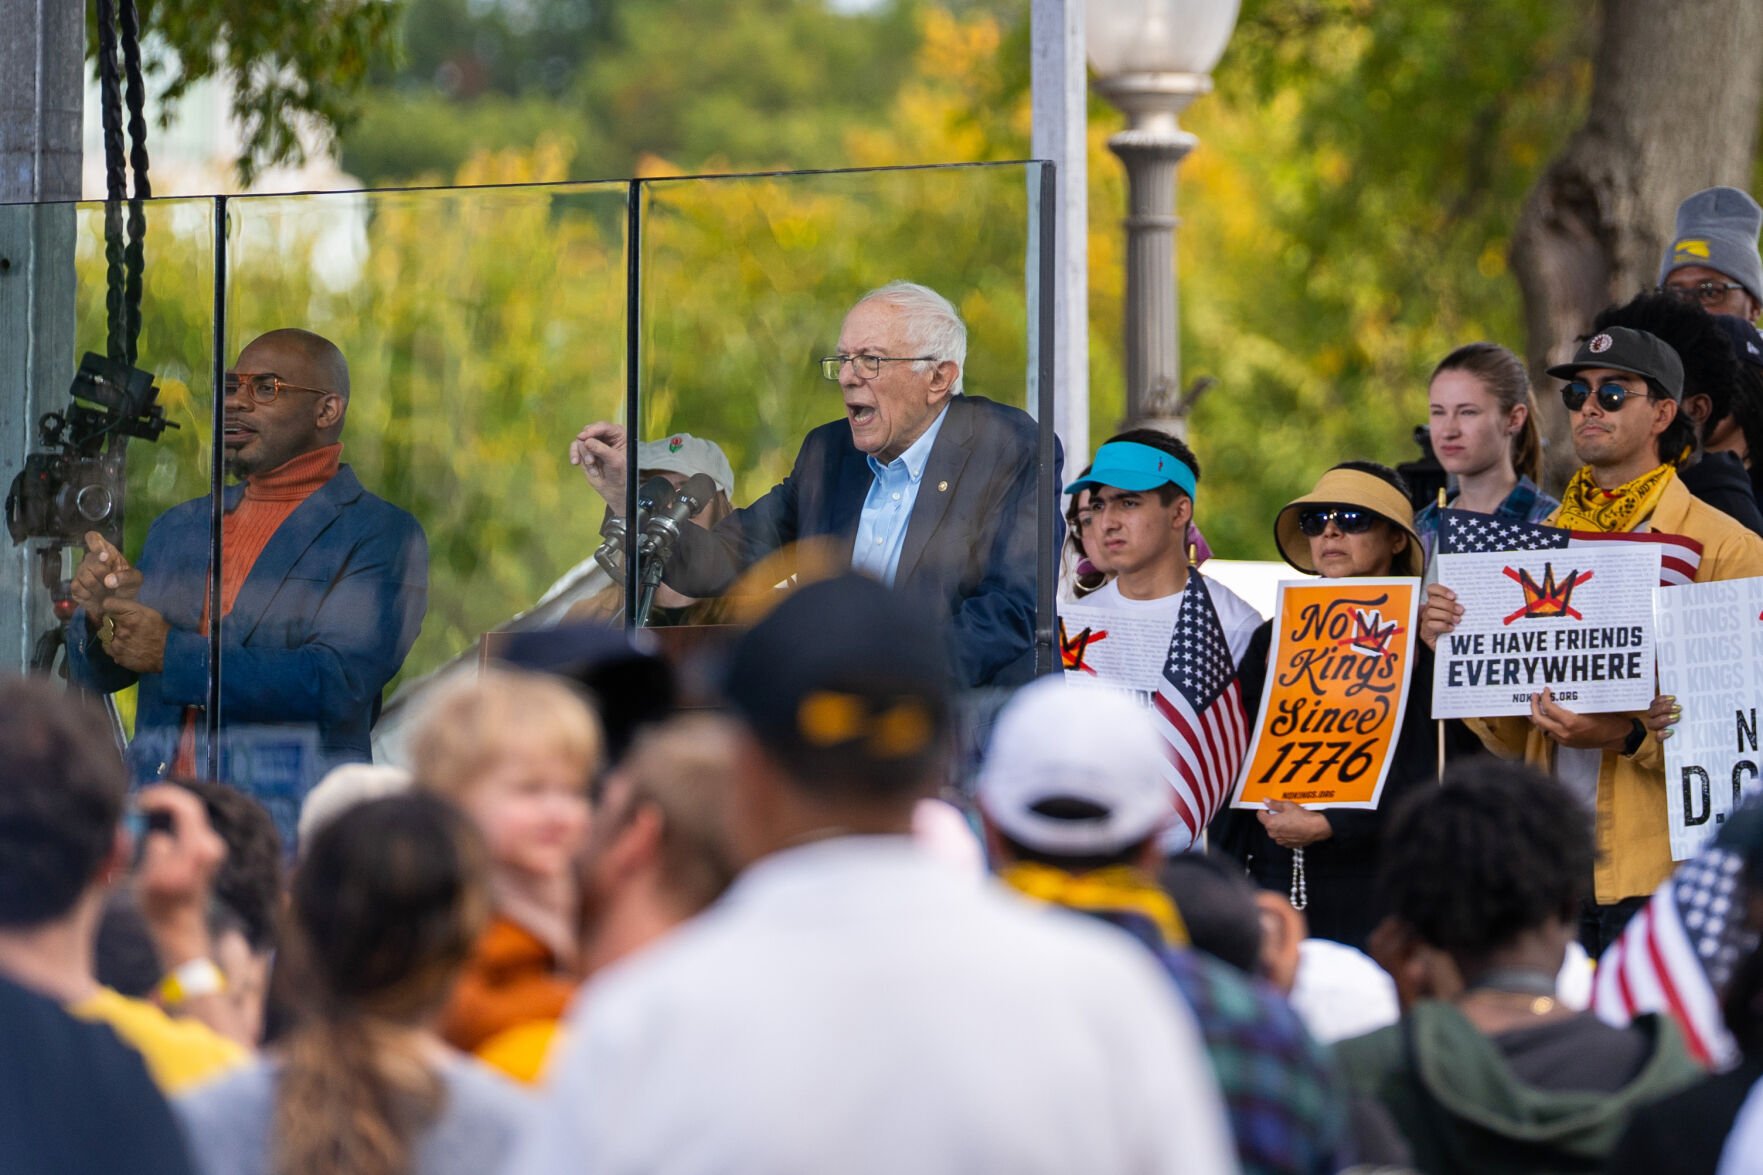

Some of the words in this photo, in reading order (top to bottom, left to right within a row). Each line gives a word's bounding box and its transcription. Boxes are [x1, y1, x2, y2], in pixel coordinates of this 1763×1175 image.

[1681, 580, 1739, 607] KINGS
[1681, 604, 1740, 635] KINGS
[1450, 634, 1485, 655] WE
[1492, 631, 1548, 654] HAVE
[1555, 626, 1643, 651] FRIENDS
[1685, 633, 1743, 664] KINGS
[1278, 646, 1399, 697] Kings
[1448, 651, 1642, 688] EVERYWHERE
[1687, 662, 1745, 693] KINGS
[1512, 691, 1579, 703] NOKS.ORG
[1270, 695, 1390, 738] Since
[1257, 737, 1380, 784] 1776
